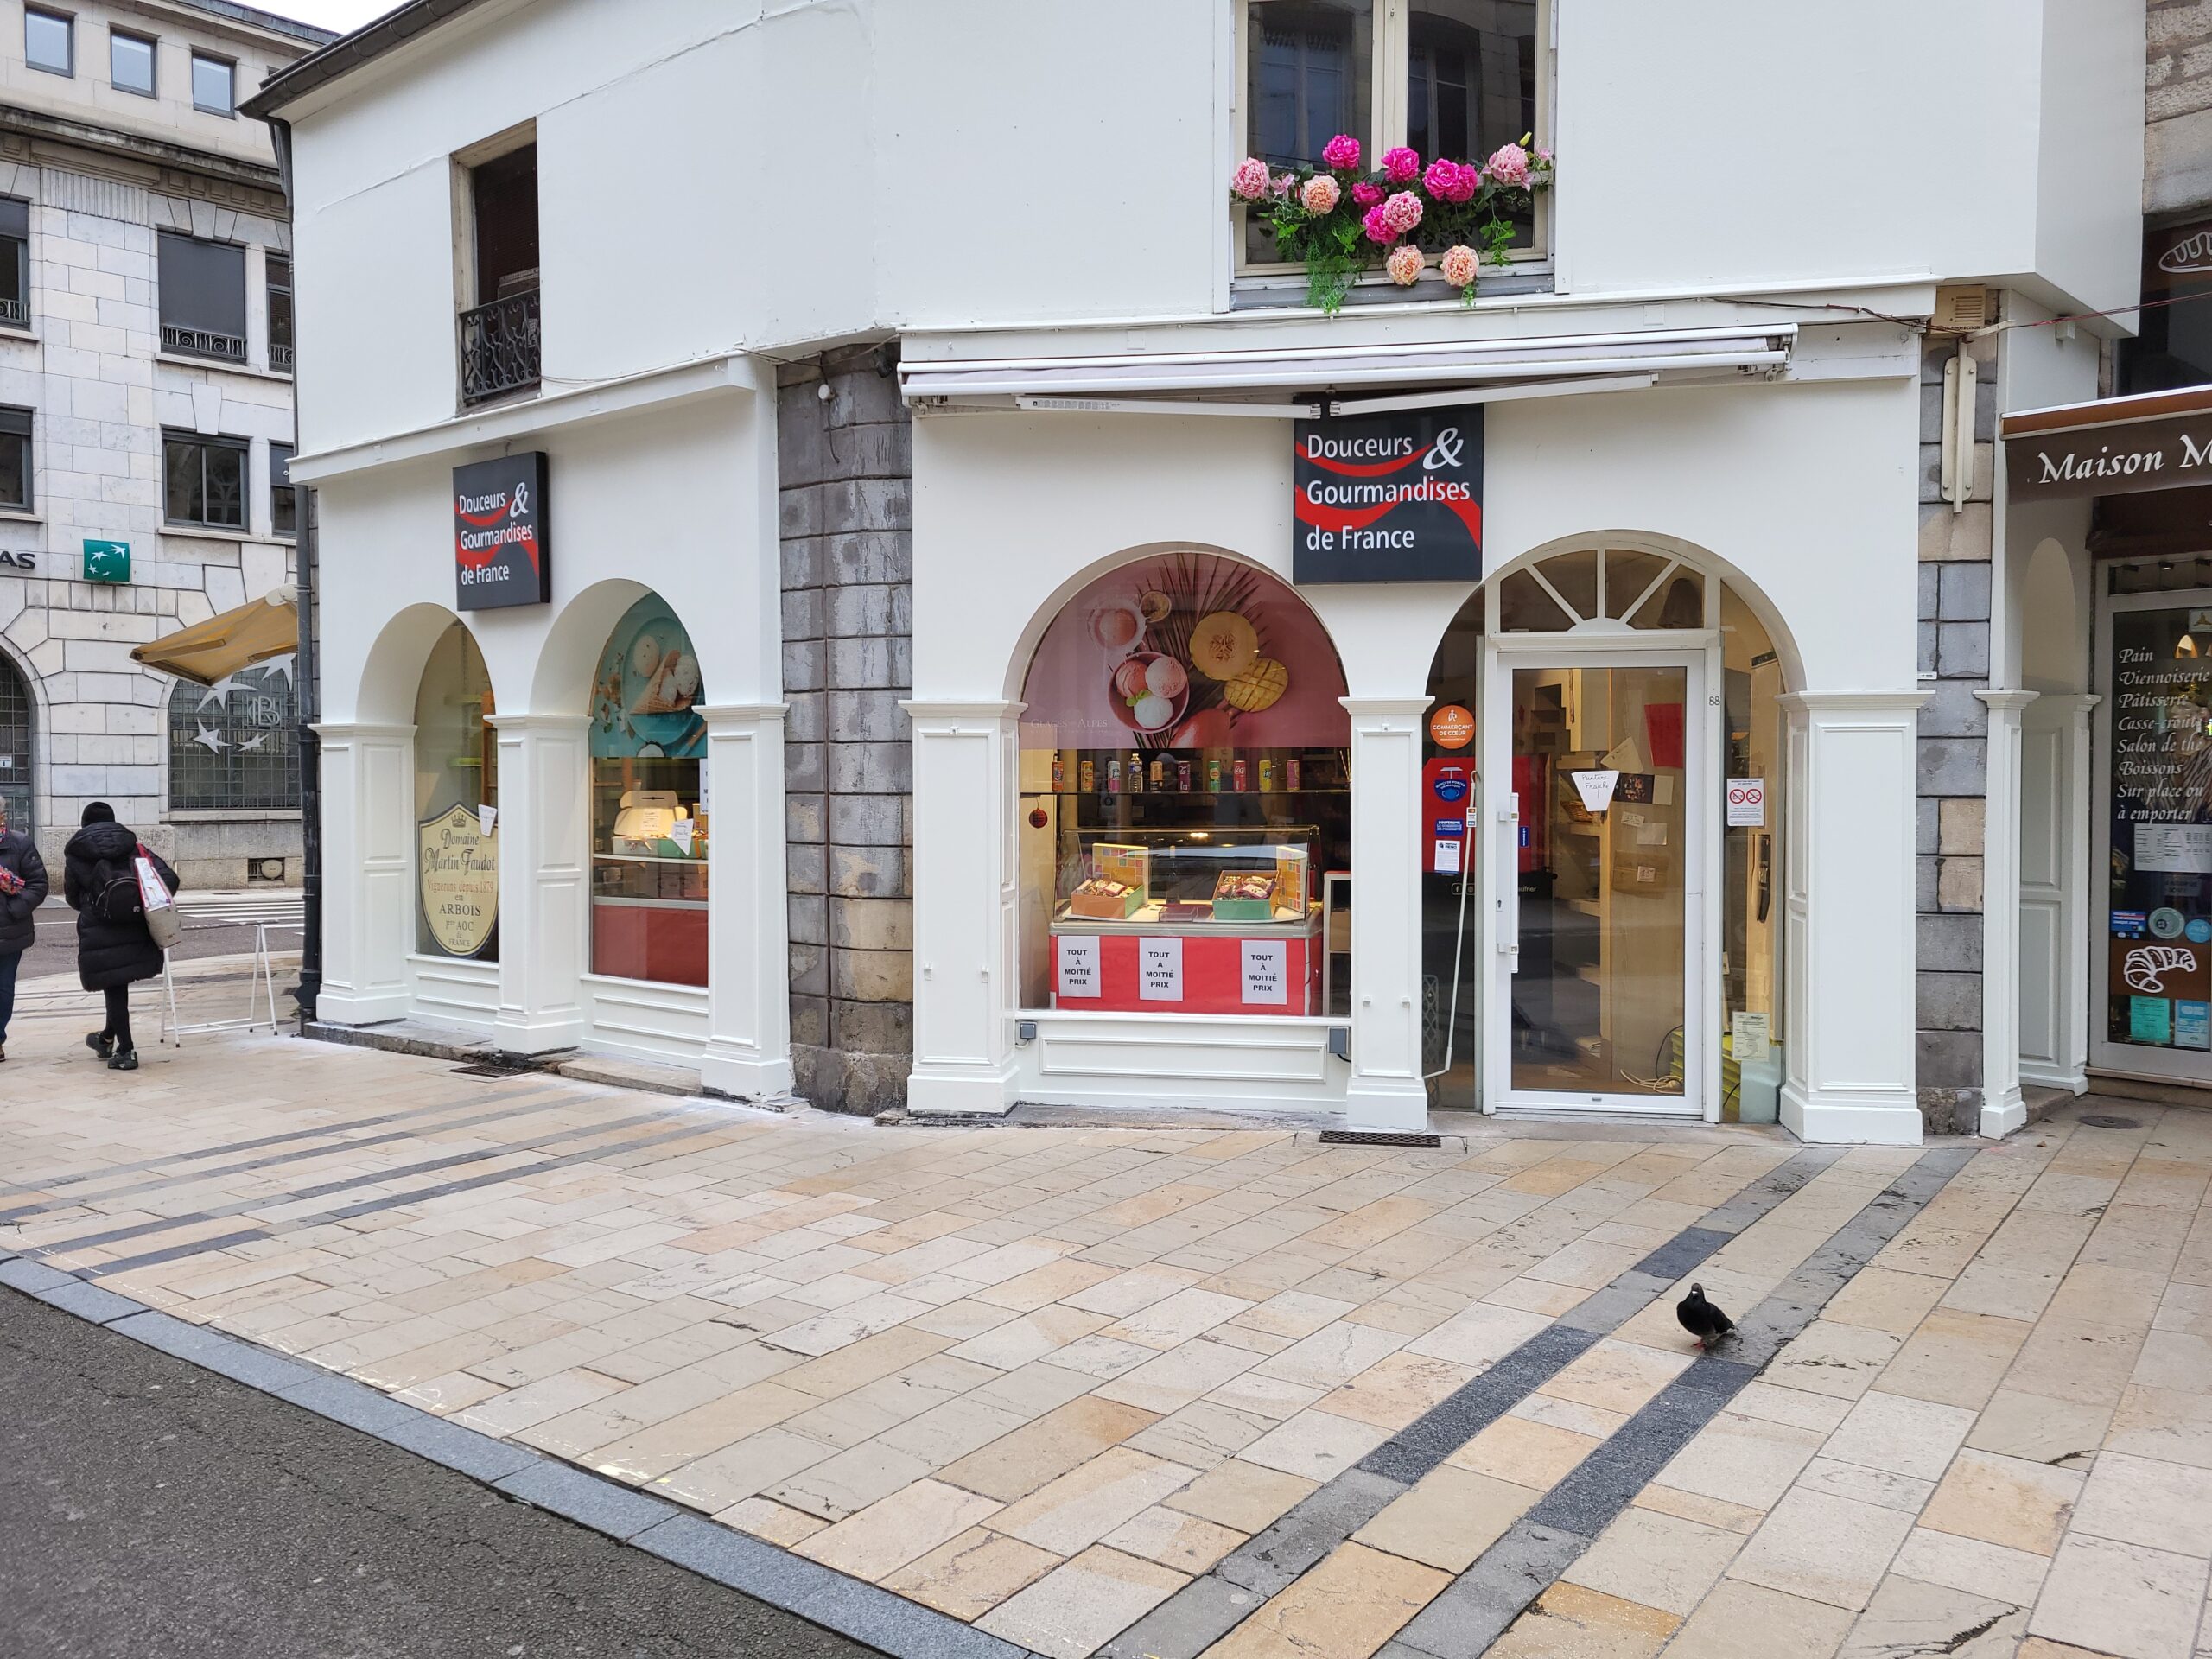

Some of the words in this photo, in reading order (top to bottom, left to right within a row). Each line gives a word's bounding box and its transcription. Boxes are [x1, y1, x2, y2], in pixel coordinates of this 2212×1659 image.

[1307, 434, 1413, 459] Douceurs
[1422, 427, 1465, 470] &
[2037, 446, 2164, 484] Maison
[1306, 475, 1471, 505] Gourmandises
[459, 491, 505, 515] Douceurs
[509, 482, 529, 518] &
[460, 522, 533, 550] Gourmandises
[1306, 524, 1334, 550] de
[1342, 525, 1415, 550] France
[461, 565, 474, 586] de
[476, 563, 509, 583] France
[2118, 646, 2154, 664] Pain
[2118, 666, 2210, 685] Viennoiserie
[1709, 696, 1720, 706] 88
[2118, 692, 2189, 709] Pâtisserie
[2117, 733, 2157, 753] Salon
[2160, 733, 2177, 752] de
[2119, 761, 2183, 776] Boissons
[2117, 784, 2144, 798] Sur
[2145, 778, 2182, 804] place
[2185, 786, 2204, 798] ou
[2117, 804, 2126, 820] à
[2129, 807, 2192, 824] emporter
[441, 828, 480, 849] Domaine
[424, 847, 460, 874] Martin
[461, 849, 495, 876] Faudot
[428, 879, 456, 893] Vignerons
[459, 880, 479, 893] depuis
[439, 903, 481, 916] ARBOIS
[456, 921, 474, 931] AOC
[449, 938, 471, 947] FRANCE
[1065, 967, 1091, 976] MOITIÉ
[1146, 969, 1173, 978] MOITIÉ
[1248, 972, 1278, 982] MOITIÉ
